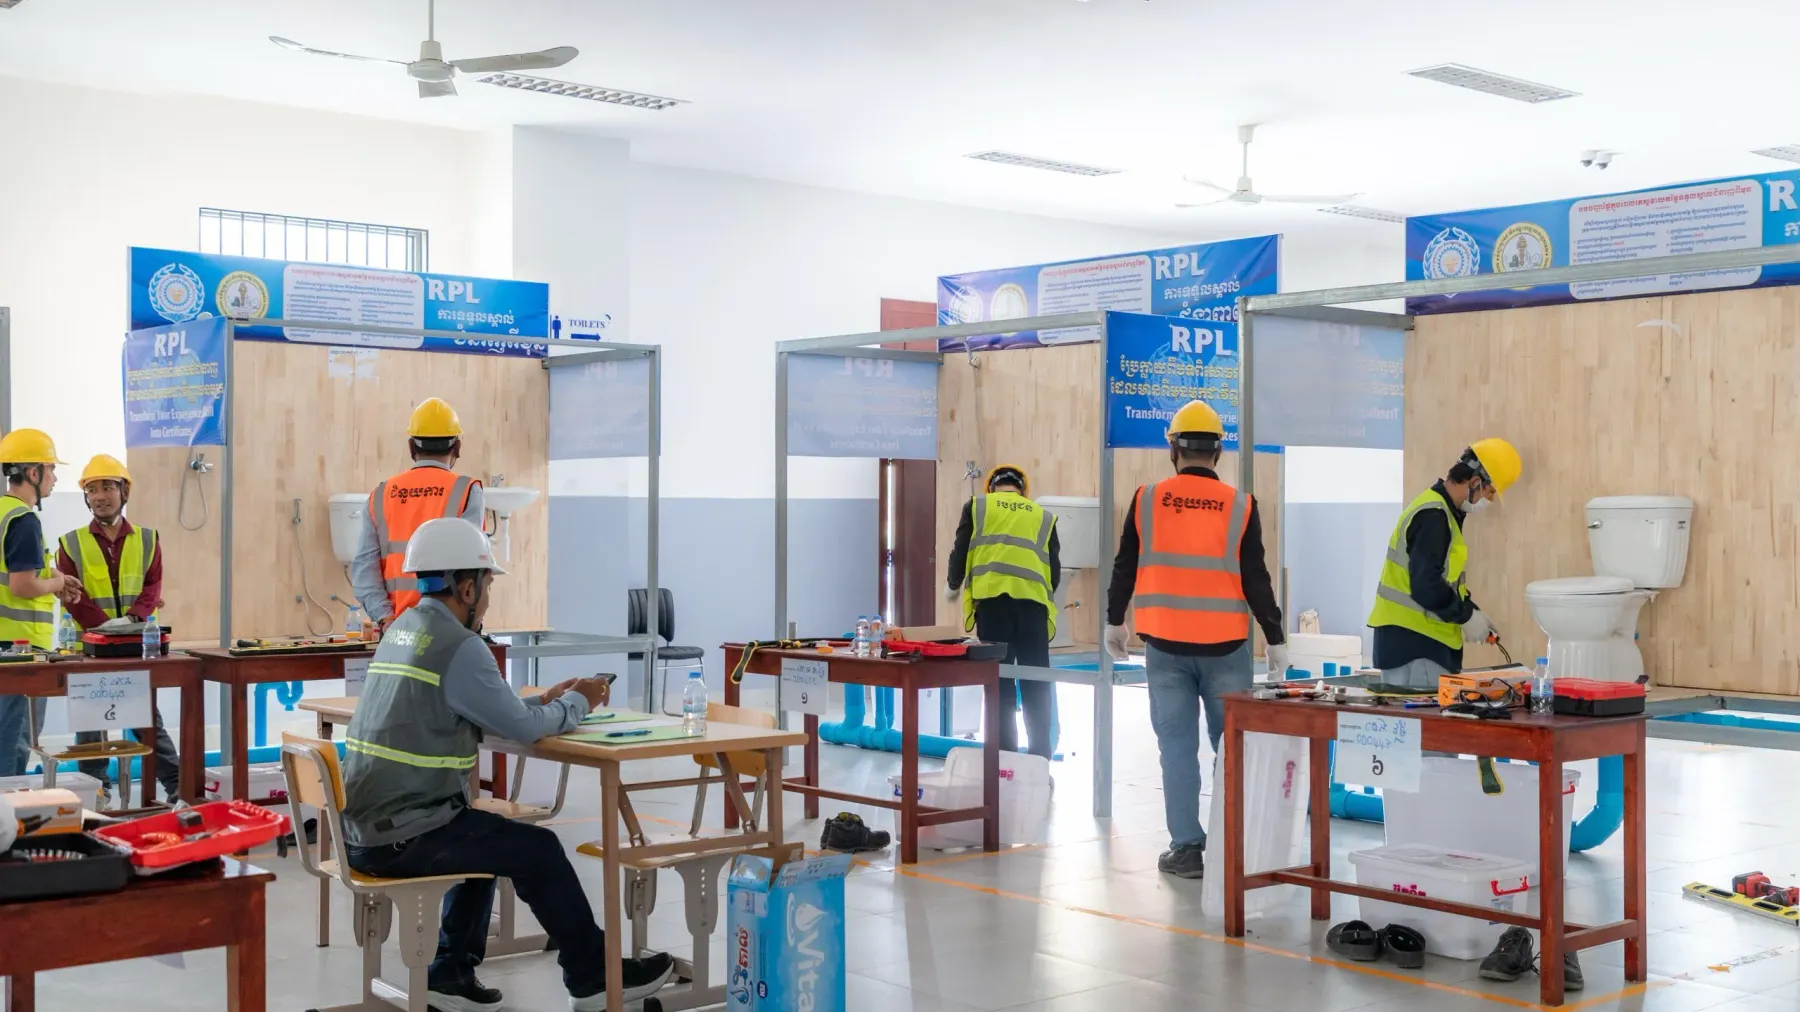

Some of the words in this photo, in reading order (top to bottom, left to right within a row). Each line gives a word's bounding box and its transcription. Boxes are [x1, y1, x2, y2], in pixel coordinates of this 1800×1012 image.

[1154, 252, 1205, 281] RPL
[427, 278, 481, 304] RPL
[568, 318, 606, 329] TOILETS
[154, 330, 190, 358] RPL
[1171, 324, 1232, 356] RPL
[1125, 406, 1175, 420] Transform
